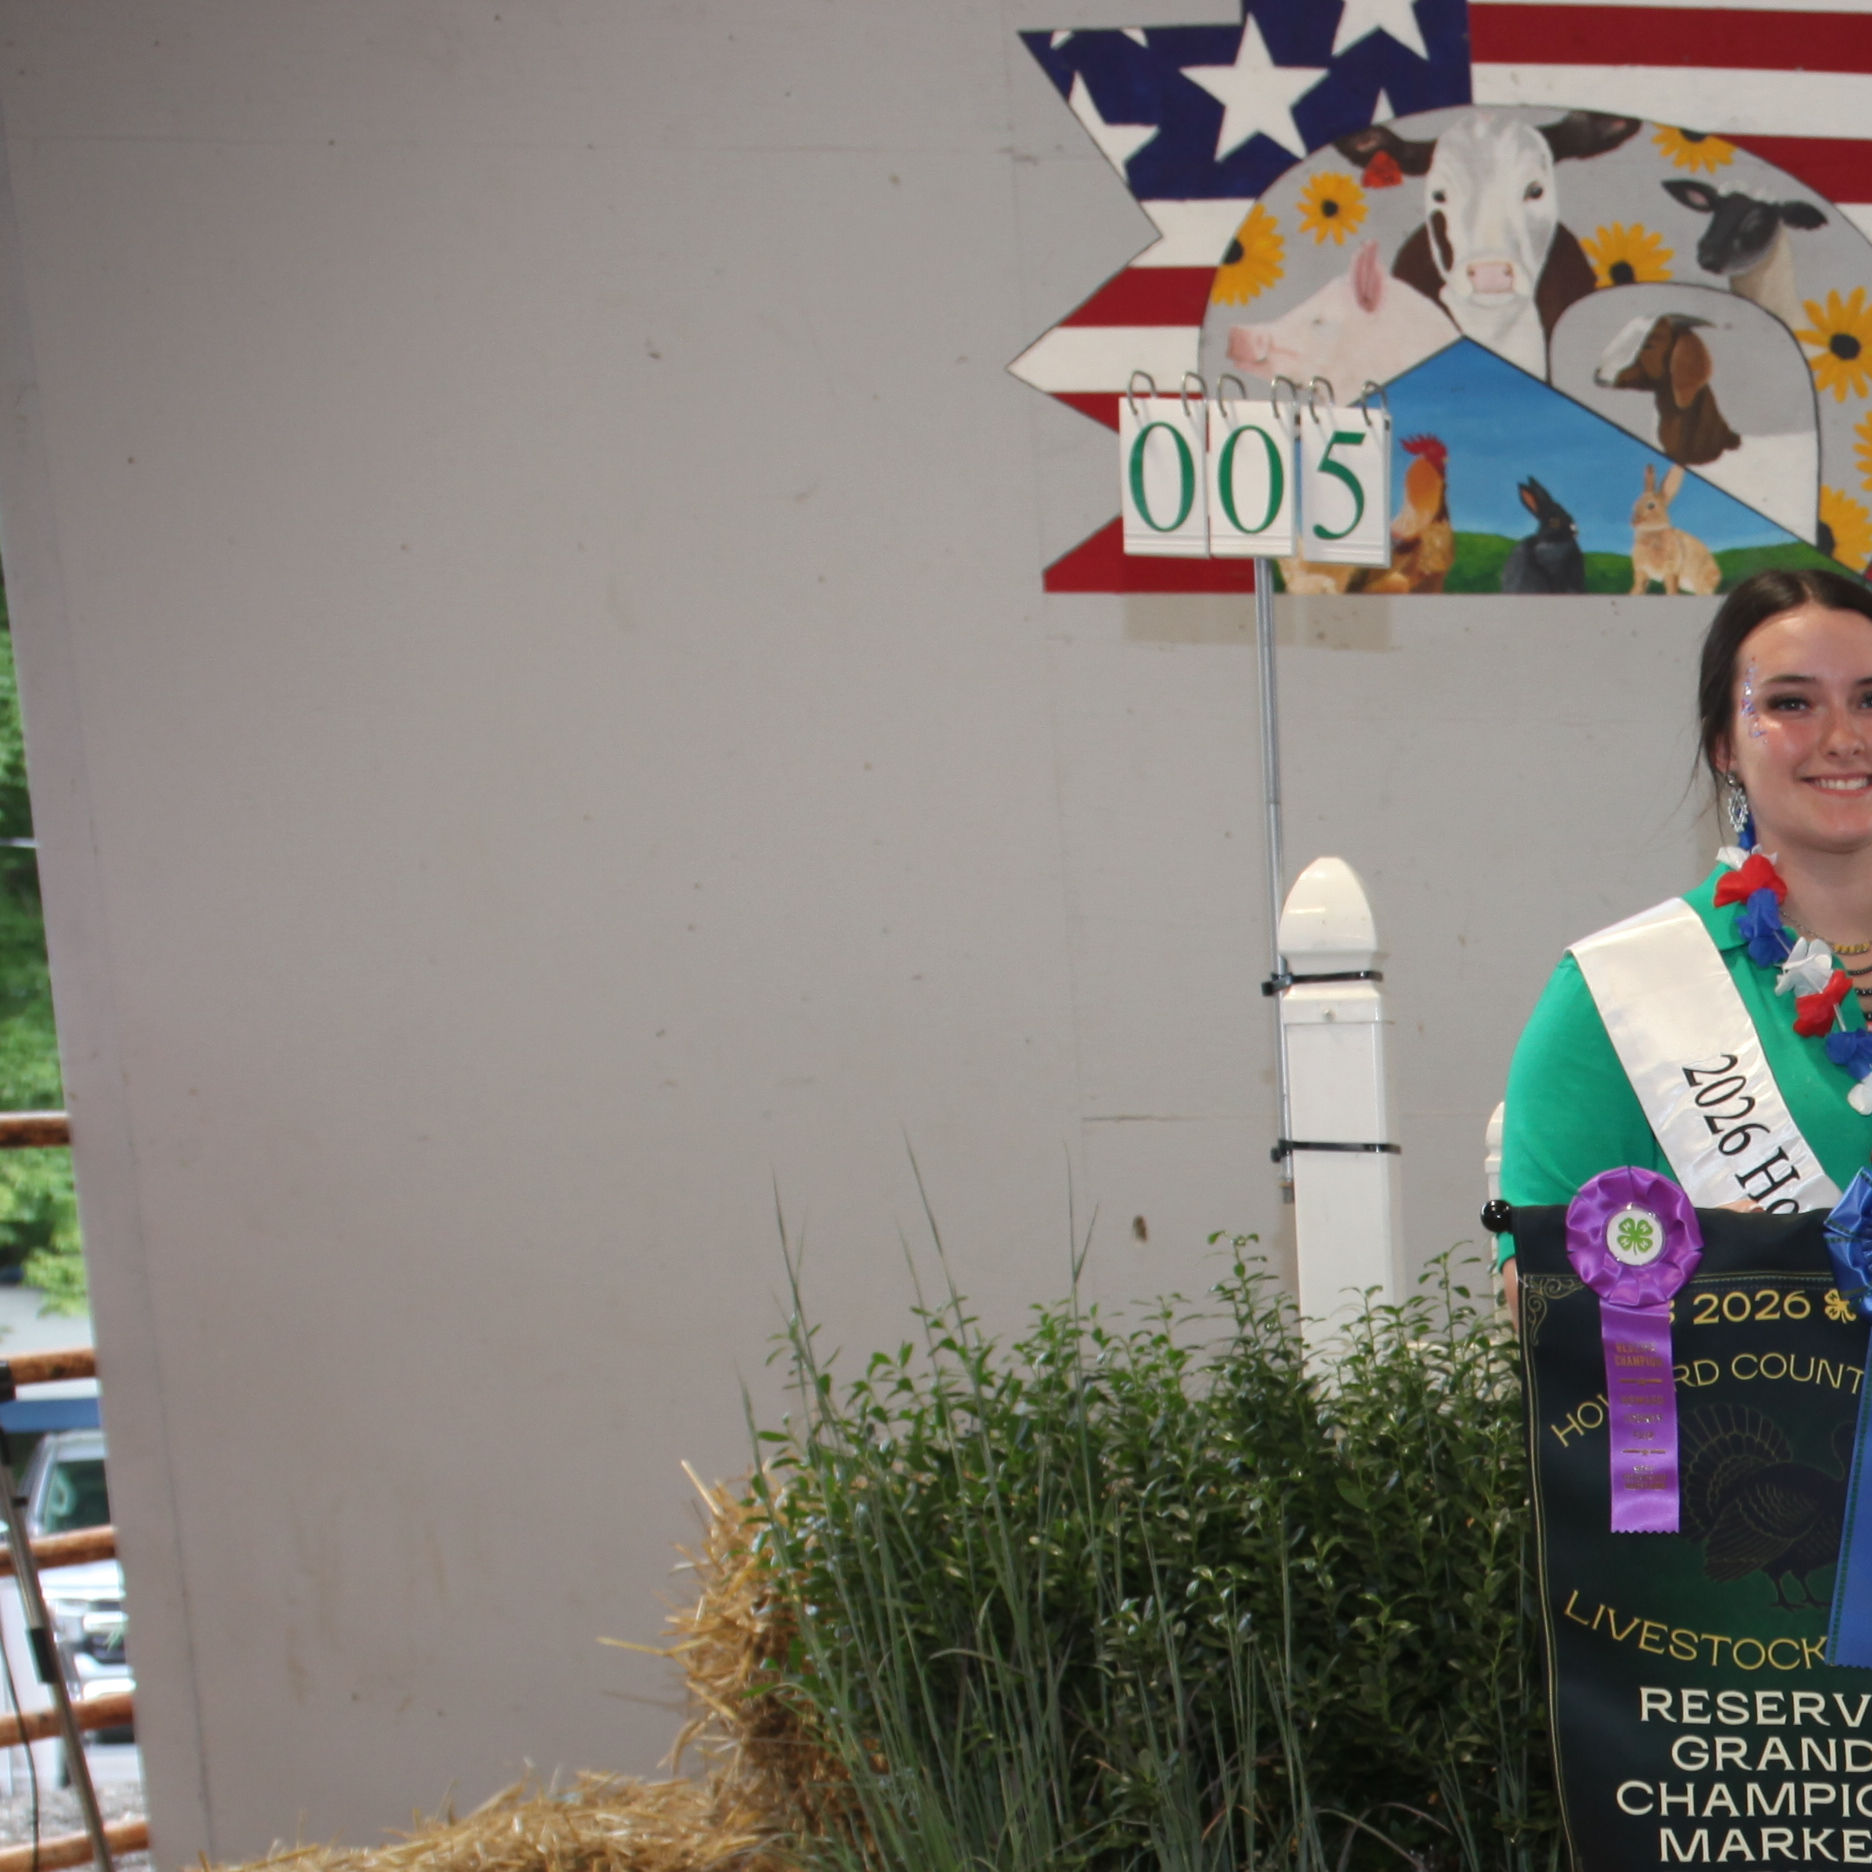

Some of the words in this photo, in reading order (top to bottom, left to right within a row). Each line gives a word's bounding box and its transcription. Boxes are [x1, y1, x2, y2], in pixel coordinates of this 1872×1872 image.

[1128, 421, 1365, 540] 005
[1681, 1053, 1771, 1157] 2026
[1692, 1289, 1812, 1325] 2026
[1550, 1359, 1720, 1447] HORD
[1731, 1352, 1866, 1395] COUNT
[1563, 1589, 1829, 1671] LIVESTOCK
